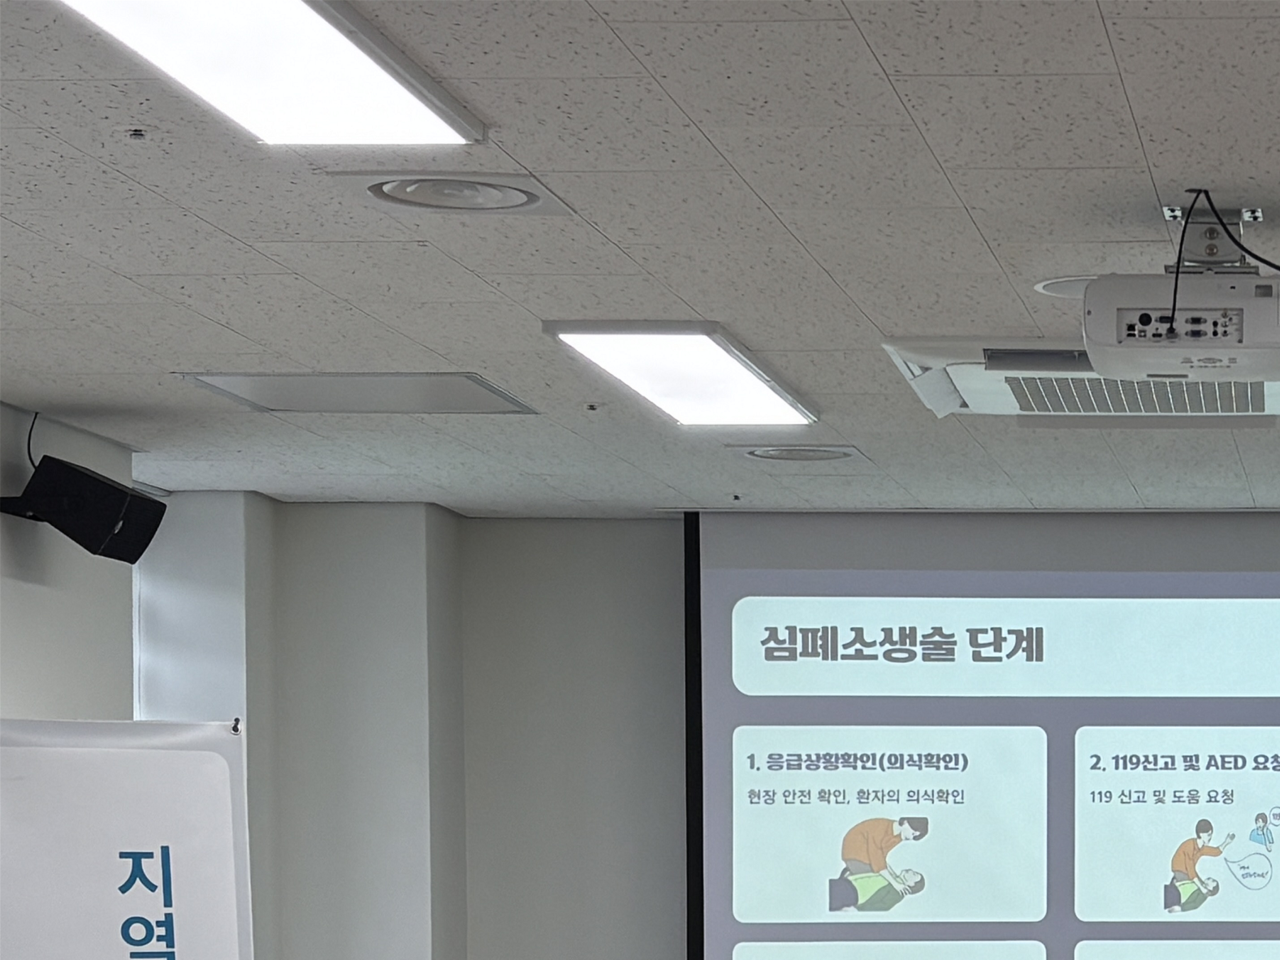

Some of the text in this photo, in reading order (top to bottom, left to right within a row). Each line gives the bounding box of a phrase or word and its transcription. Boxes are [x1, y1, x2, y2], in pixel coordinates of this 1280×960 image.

[760, 625, 1044, 664] 심폐소생술 단계
[747, 752, 969, 774] 1. 응급상황확인(의식확인)
[1090, 755, 1106, 772] 2.
[1112, 754, 1177, 772] 119신고
[1183, 754, 1200, 772] 및
[1206, 754, 1247, 771] AED
[748, 788, 965, 807] 현장 안전 확인, 환자의 의식확인
[1090, 789, 1234, 804] 119 신고 및 도움 요청
